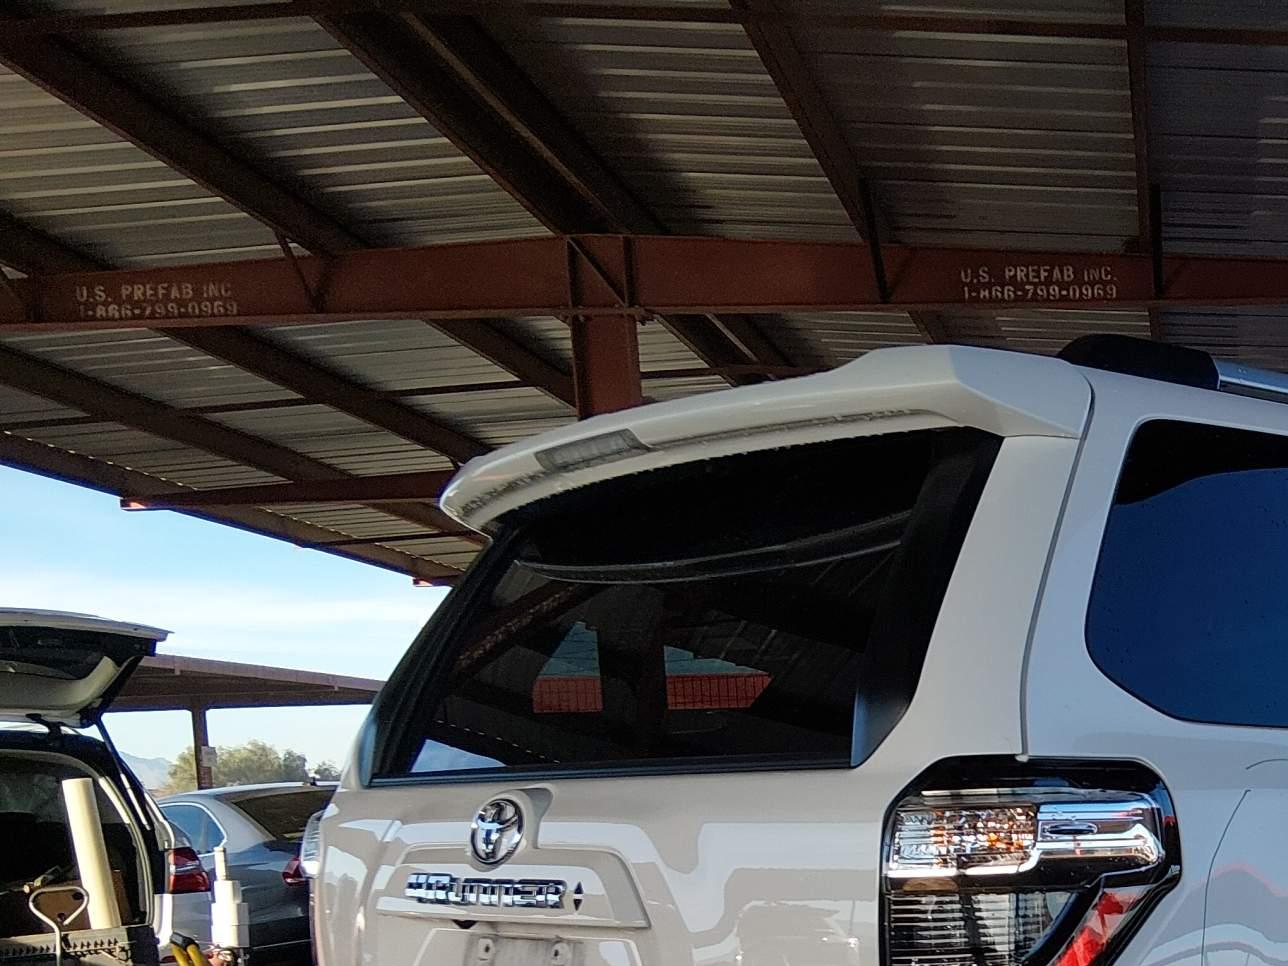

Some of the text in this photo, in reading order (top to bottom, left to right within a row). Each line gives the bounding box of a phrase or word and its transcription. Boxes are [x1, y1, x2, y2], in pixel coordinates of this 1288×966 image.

[961, 265, 1118, 284] U.S. PREFAB INC.
[76, 285, 112, 302] U.S.
[121, 283, 194, 300] PREFAB
[963, 284, 1118, 301] 1-866-799-0969
[80, 301, 239, 319] 1-866-799-0969
